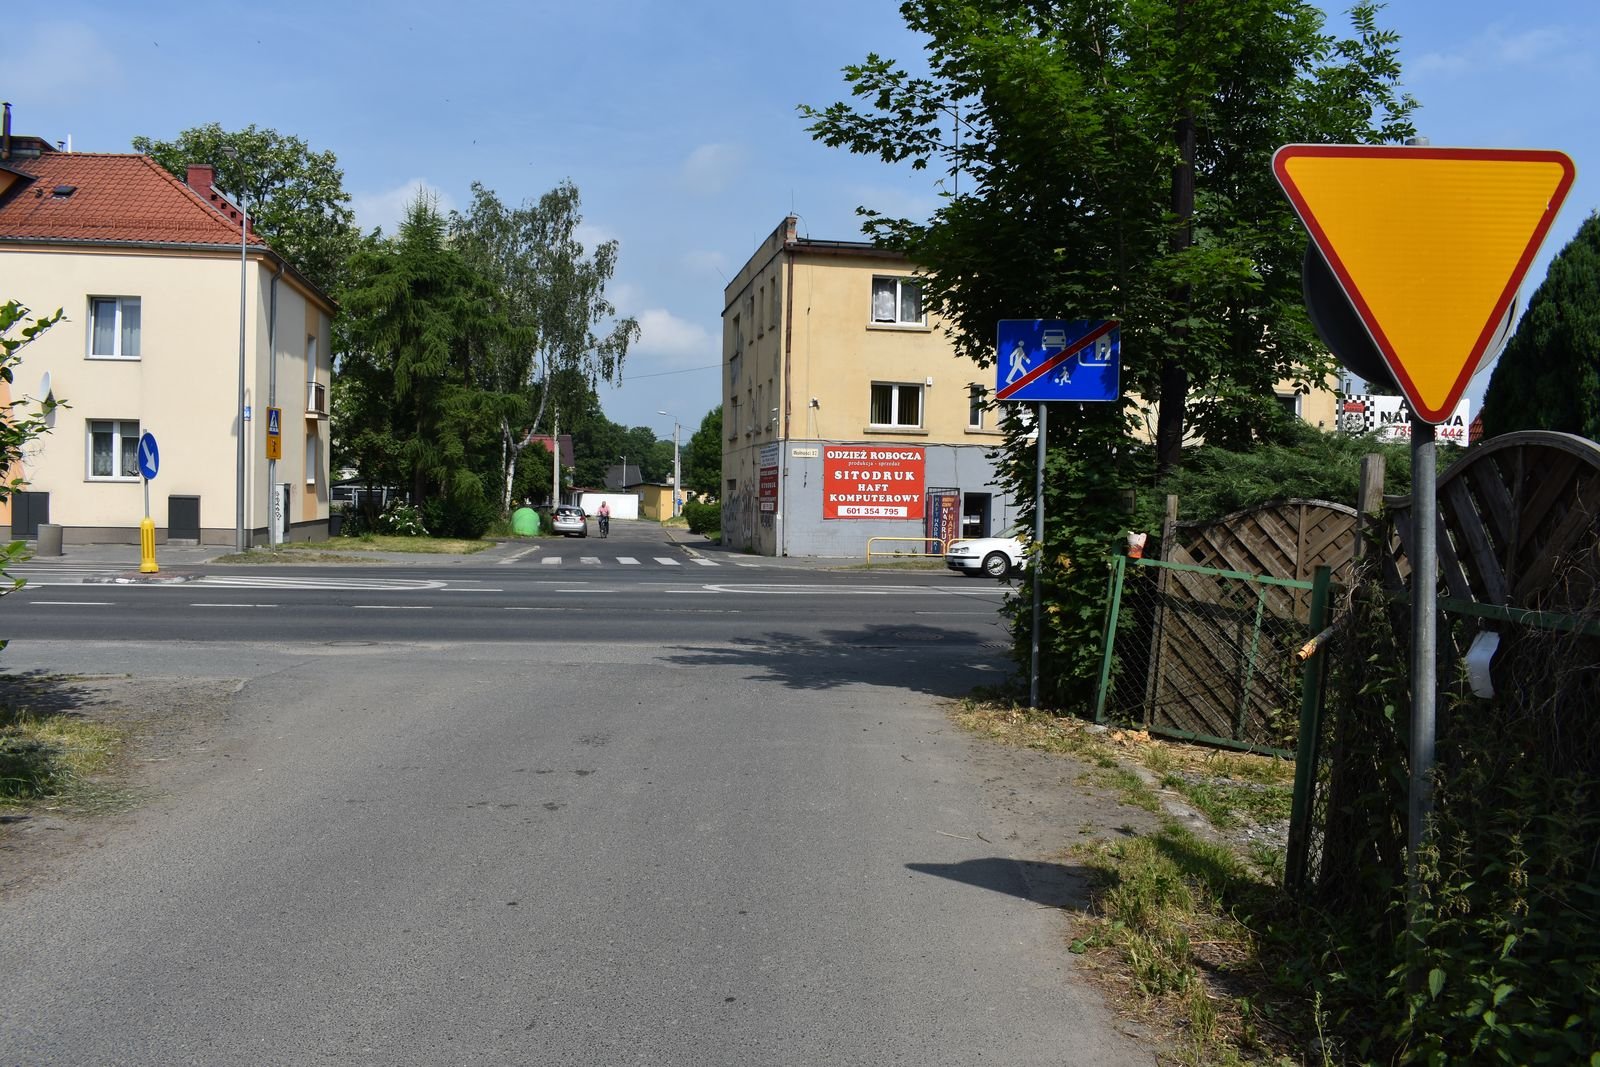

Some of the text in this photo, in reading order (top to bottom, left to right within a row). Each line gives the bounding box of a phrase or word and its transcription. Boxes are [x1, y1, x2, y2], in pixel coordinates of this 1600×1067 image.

[1441, 428, 1463, 438] 444
[827, 450, 921, 460] ODZIEŻ ROBOCZA
[834, 470, 915, 480] SITODRUK
[829, 494, 920, 502] KOMPUTEROWY
